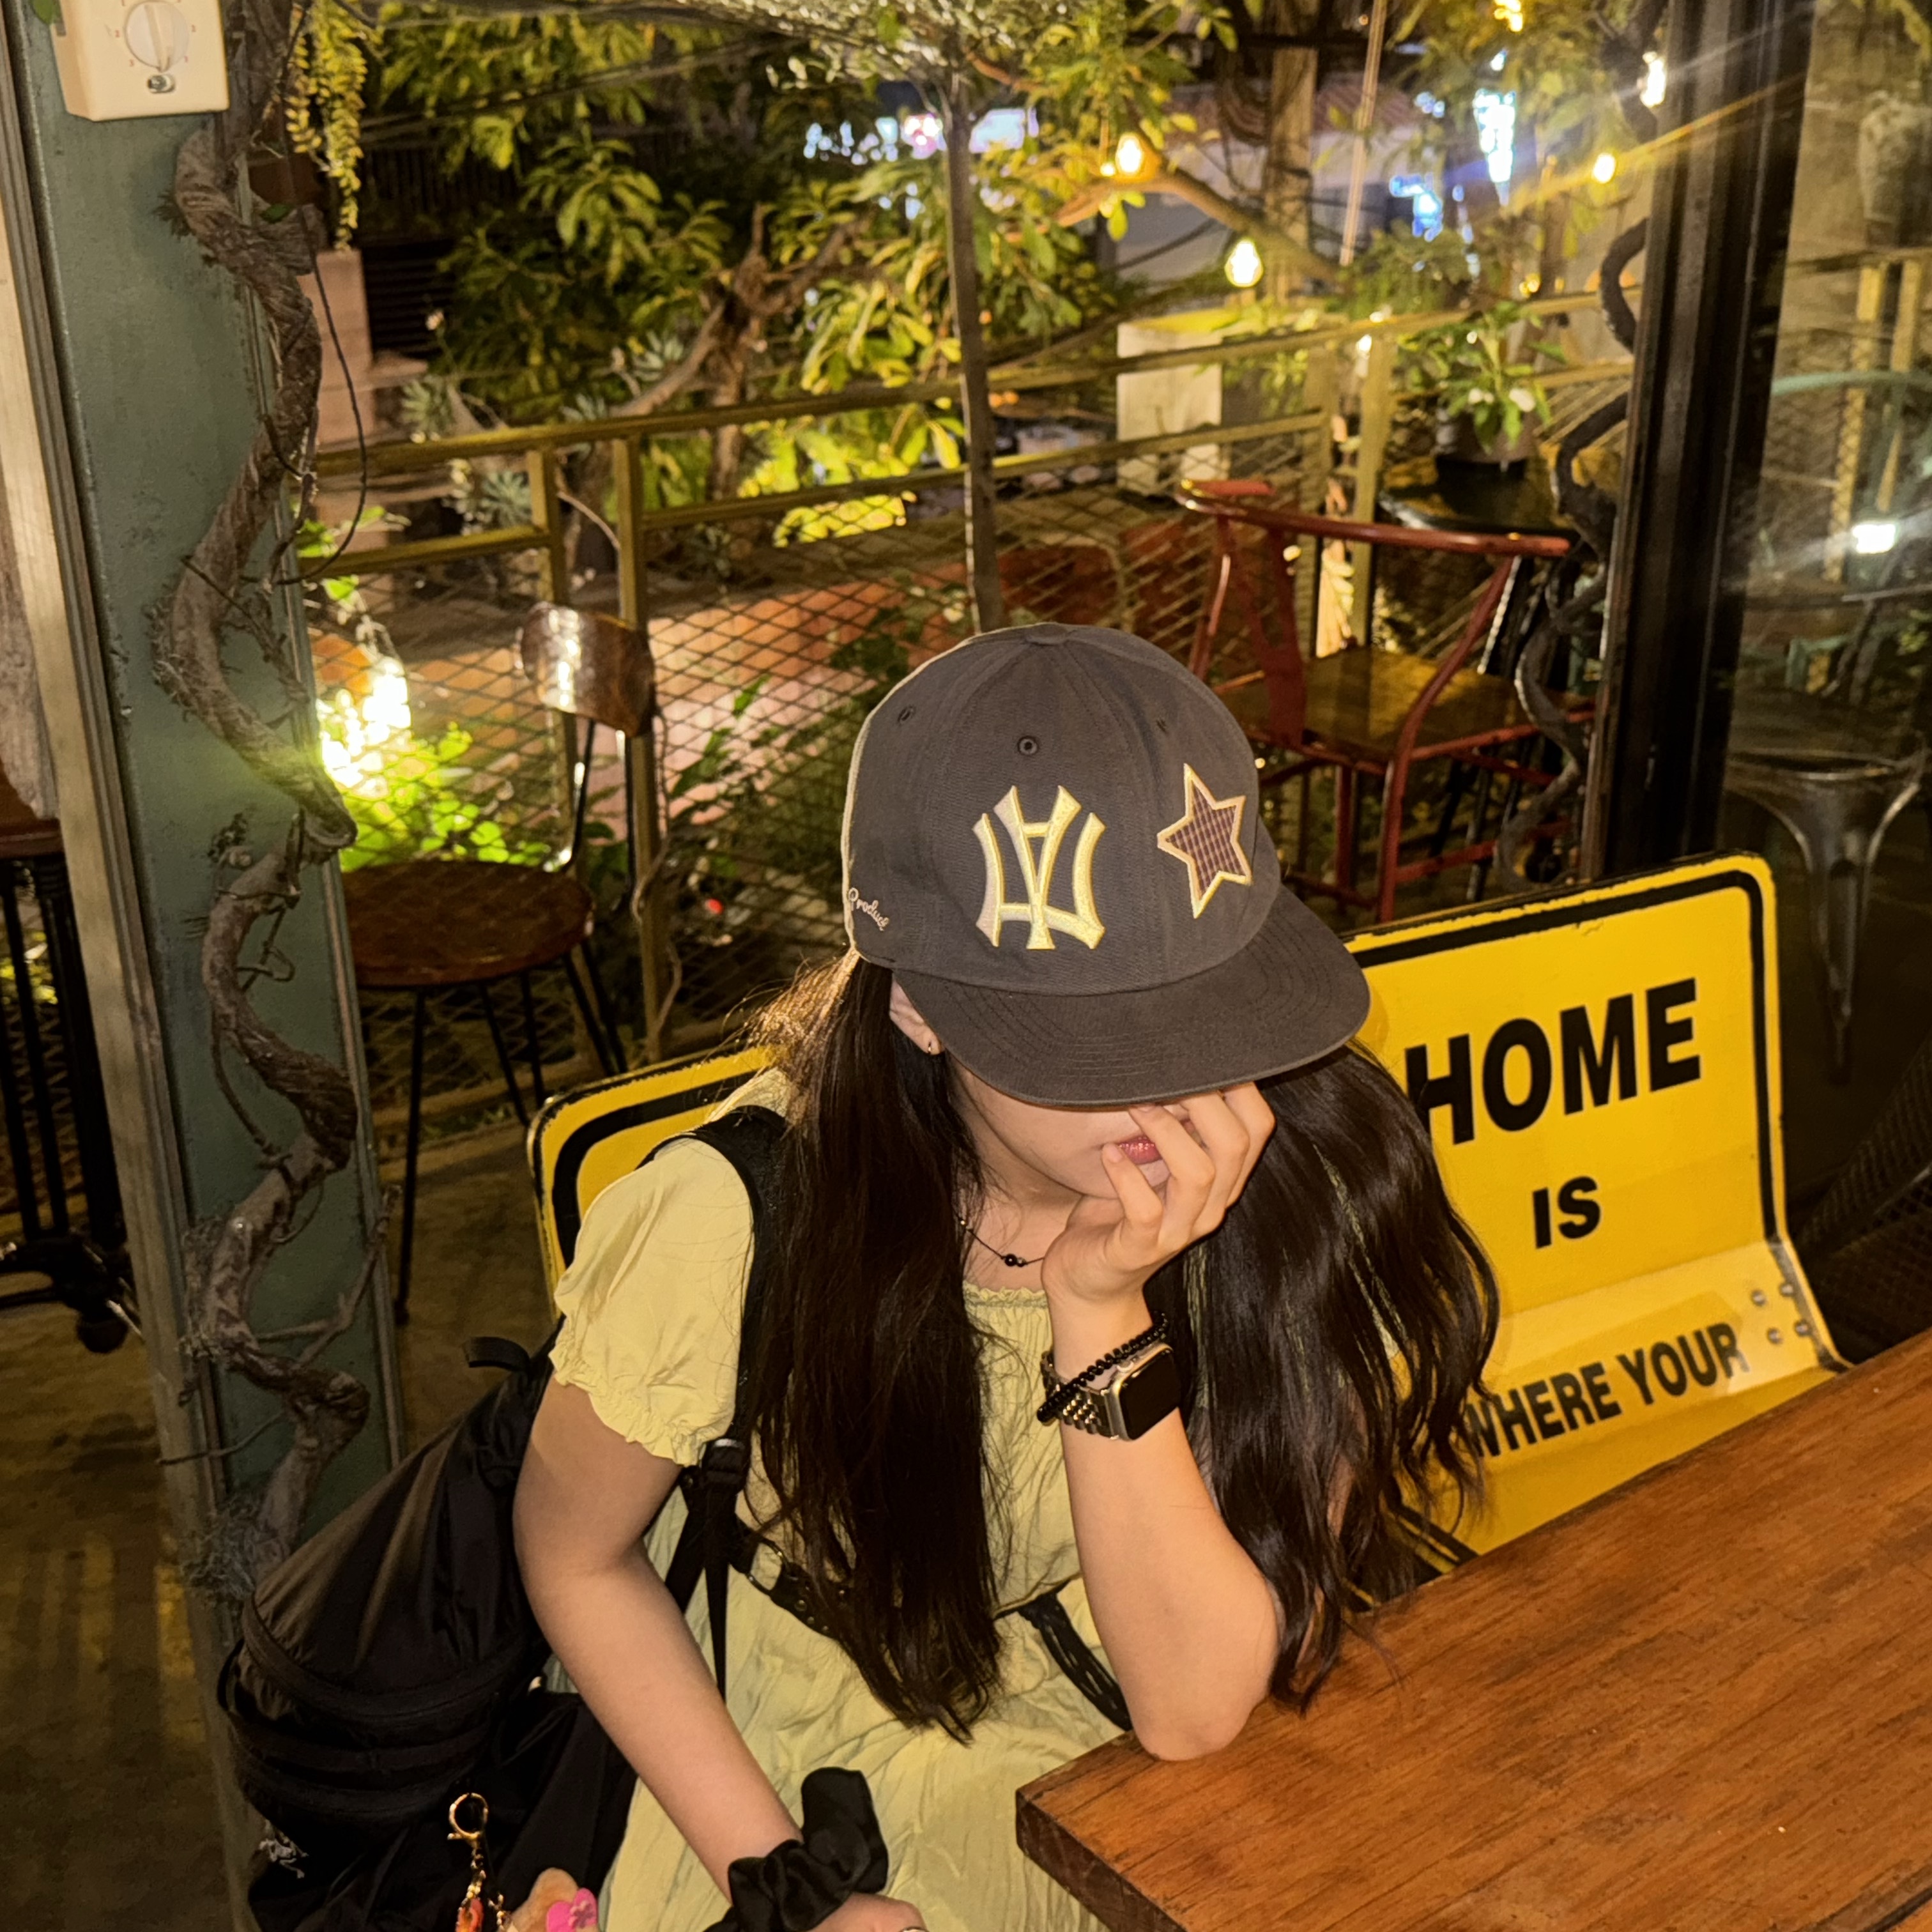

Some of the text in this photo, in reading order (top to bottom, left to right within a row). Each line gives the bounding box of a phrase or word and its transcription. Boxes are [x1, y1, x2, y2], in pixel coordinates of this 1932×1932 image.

[1405, 977, 1701, 1146] HOME
[1532, 1176, 1601, 1249] IS
[1616, 1322, 1751, 1406] YOUR
